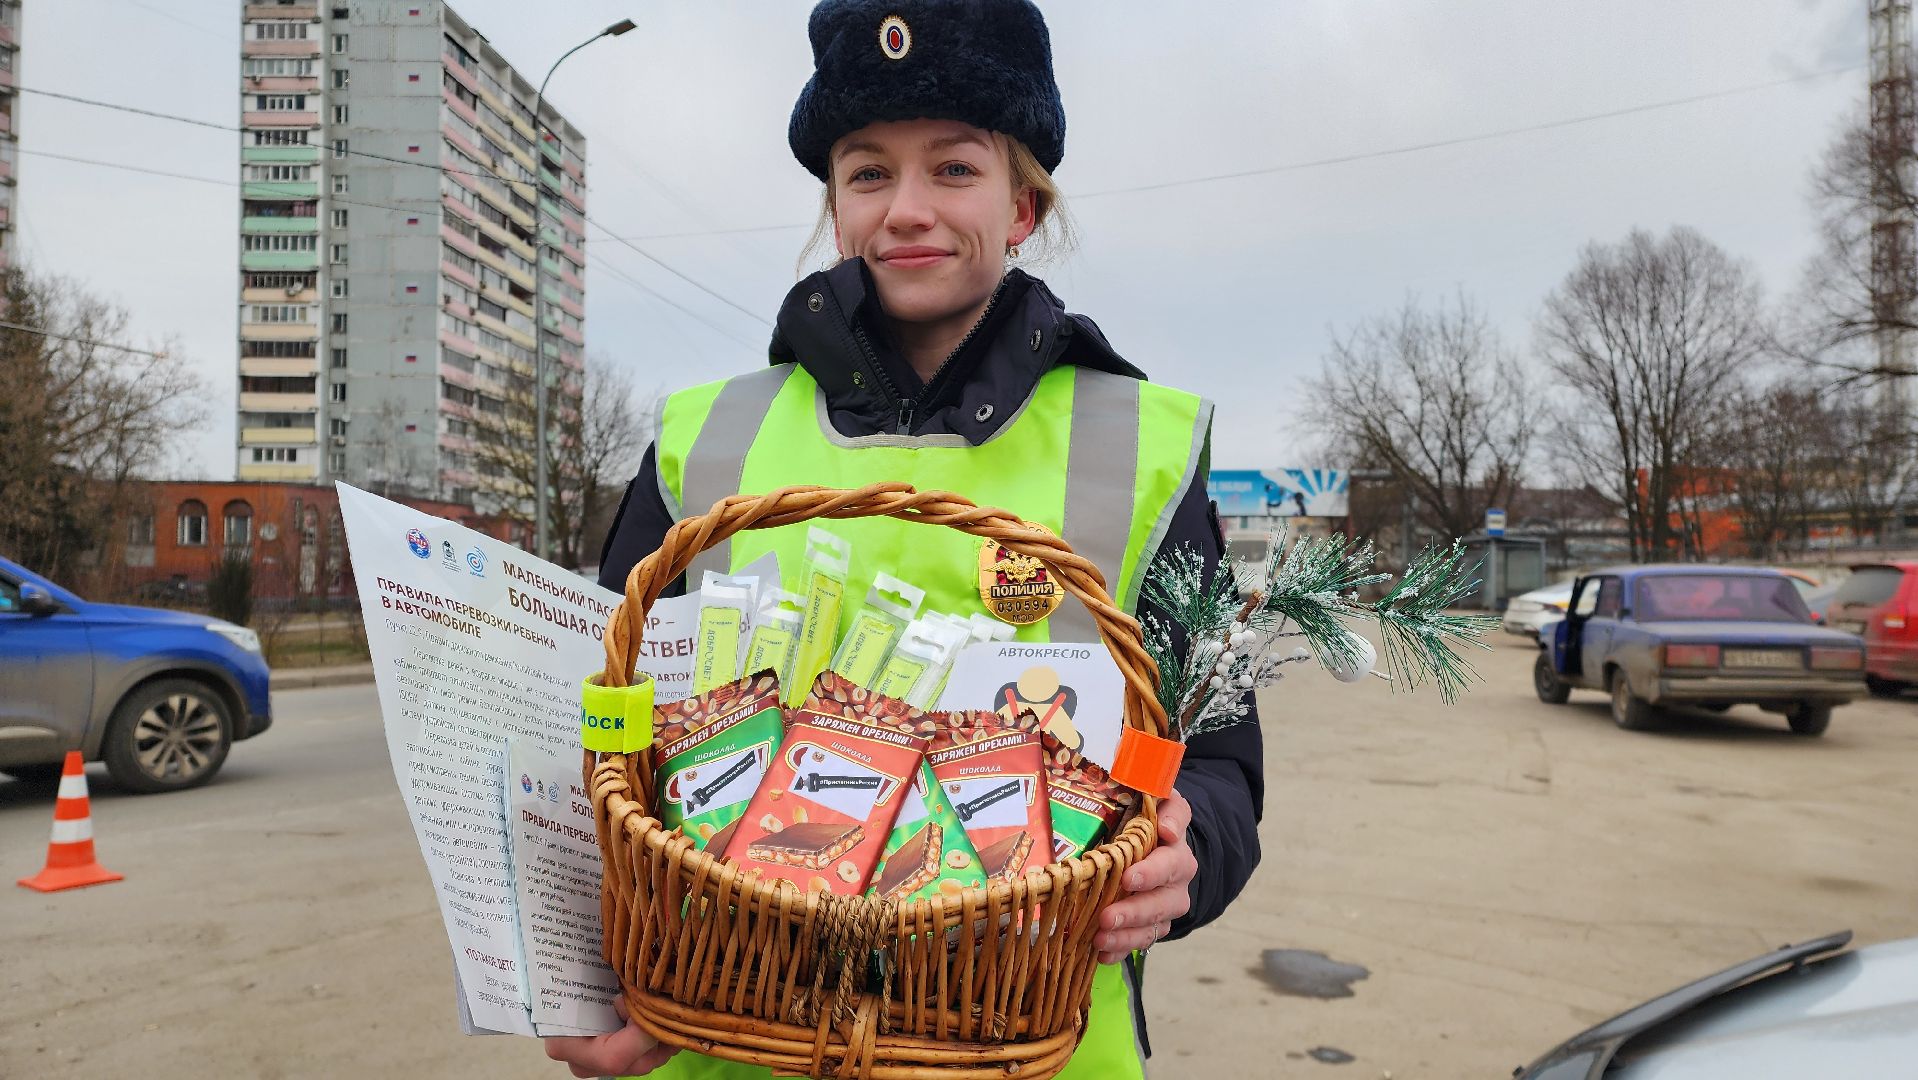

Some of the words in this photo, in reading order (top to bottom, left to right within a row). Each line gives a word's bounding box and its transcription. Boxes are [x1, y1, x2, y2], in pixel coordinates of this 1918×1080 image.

[503, 559, 586, 608] МАЛЕНЬКИЙ
[992, 583, 1053, 597] ПОЛИЦИЯ
[377, 576, 444, 609] ПРАВИЛА
[444, 598, 512, 634] ПЕРЕВОЗКИ
[513, 623, 557, 652] РЕБЕНКА
[381, 595, 392, 609] В
[395, 598, 482, 639] АВТОМОБИЛЕ
[507, 586, 589, 637] БОЛЬШАЯ
[997, 599, 1049, 613] 030594
[998, 647, 1091, 660] АВТОКРЕСЛО
[664, 727, 710, 759] ЗАРЯЖЕН
[711, 703, 758, 734] ОРЕХАМИ!
[812, 715, 862, 735] ЗАРЯЖЕН
[862, 727, 913, 747] ОРЕХАМИ!
[694, 743, 736, 763] ШОКОЛАД
[831, 741, 872, 763] ШОКОЛАД
[930, 745, 976, 764] ЗАРЯЖЕН
[978, 733, 1027, 752] ОРЕХАМИ!
[959, 765, 1002, 775] ШОКОЛАД
[1051, 788, 1103, 814] ОРЕХАМИ!
[522, 809, 562, 834] ПРАВИЛА
